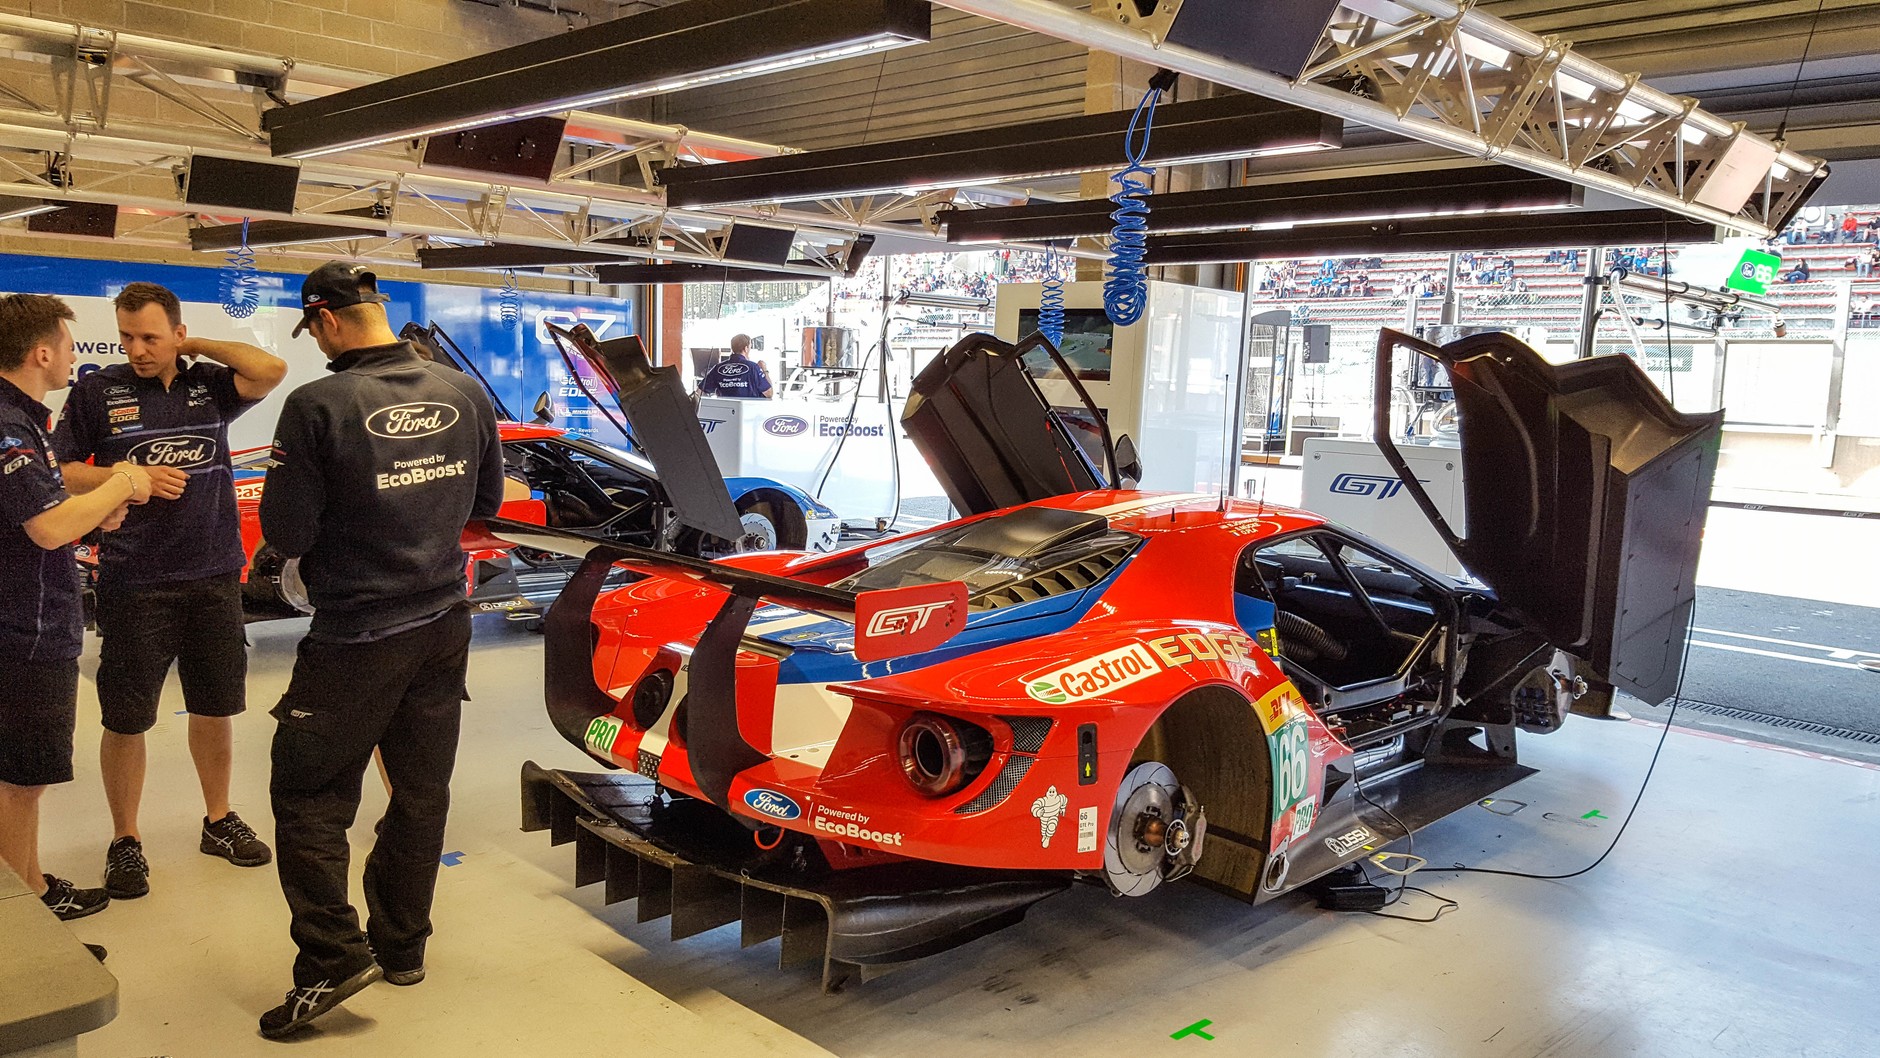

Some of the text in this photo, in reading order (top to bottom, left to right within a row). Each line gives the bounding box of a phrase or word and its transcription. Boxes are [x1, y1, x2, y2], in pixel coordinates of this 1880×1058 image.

[1755, 263, 1773, 284] 66
[536, 310, 616, 344] 67
[110, 414, 140, 423] EDGE
[386, 407, 441, 434] Ford
[699, 418, 727, 433] T
[771, 419, 800, 433] Ford
[820, 423, 884, 436] EcoBoost
[147, 440, 205, 465] Ford
[394, 454, 446, 469] Powered by
[377, 461, 465, 489] EcoBoost
[1329, 473, 1431, 500] GT
[866, 600, 954, 637] GT
[1060, 633, 1258, 697] Castrol EDGE
[586, 719, 617, 753] PRO
[1280, 725, 1307, 810] 66
[753, 792, 790, 817] Ford
[817, 804, 870, 824] Powered by
[1080, 812, 1088, 820] 66
[815, 815, 902, 846] EcoBoost
[1294, 804, 1313, 835] PRO
[1337, 826, 1370, 847] DSSV
